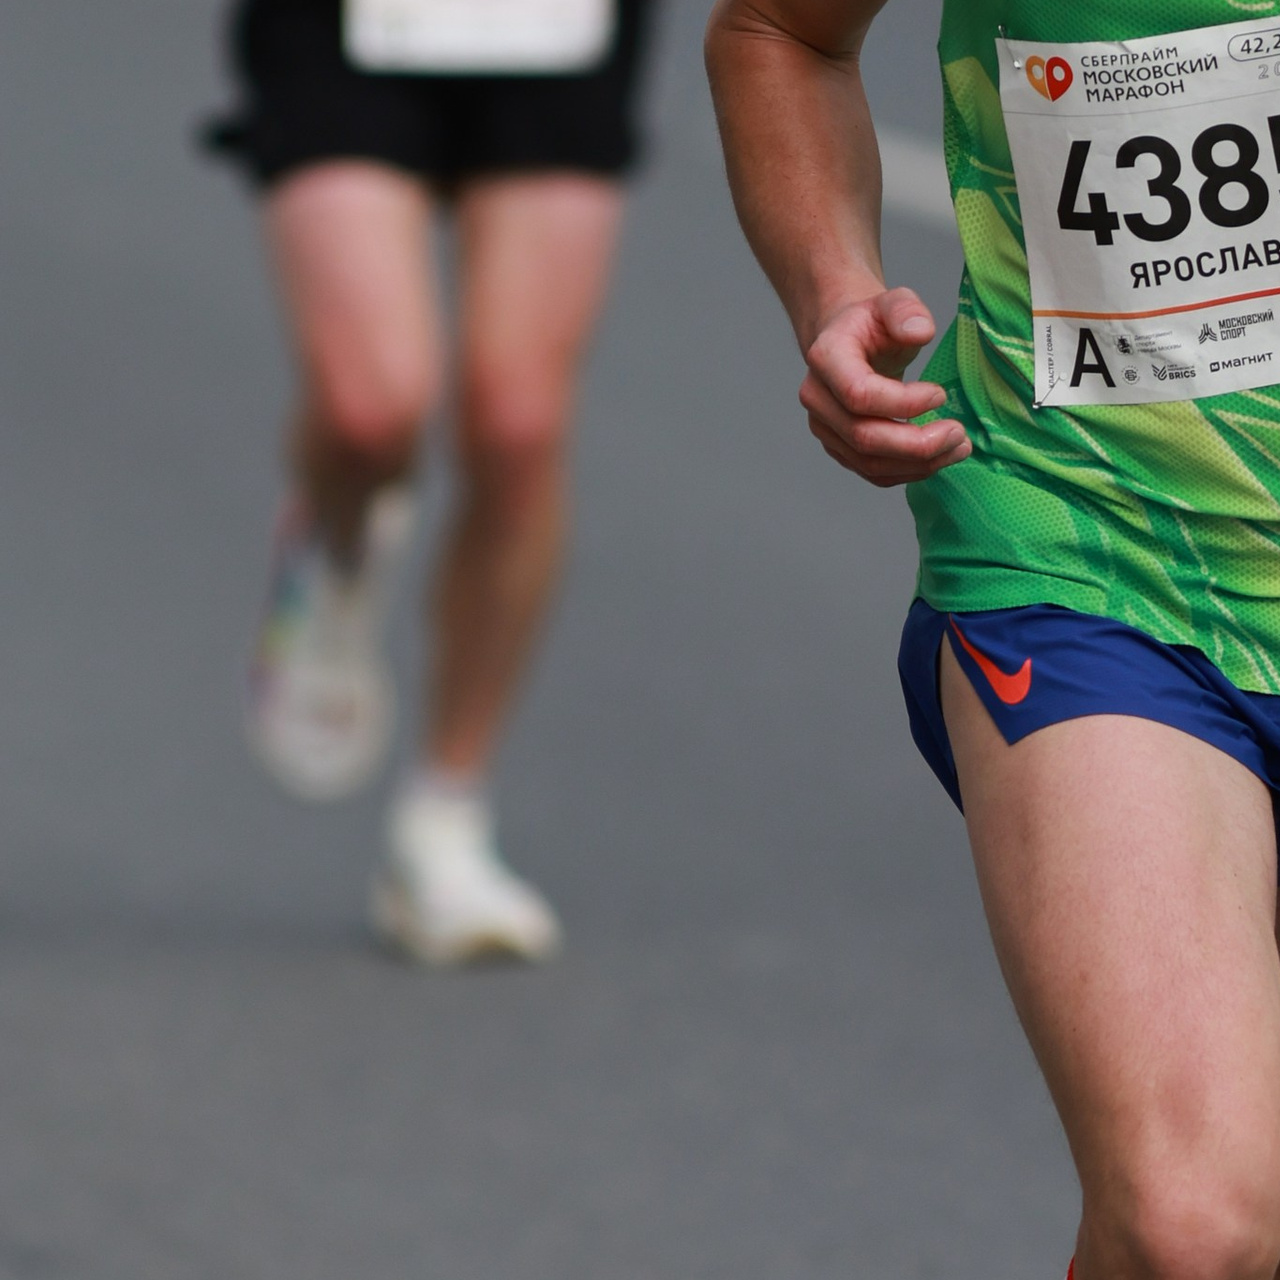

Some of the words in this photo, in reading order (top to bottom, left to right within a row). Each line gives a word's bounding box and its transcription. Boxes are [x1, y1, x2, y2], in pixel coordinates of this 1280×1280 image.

[1080, 47, 1179, 68] СБЕРПРАЙМ
[1083, 53, 1219, 86] МОСКОВСКИЙ
[1085, 79, 1185, 103] МАРАФОН
[1218, 308, 1275, 330] МОСКОВСКИЙ
[1220, 326, 1247, 341] СПОРТ
[1168, 370, 1196, 380] BRICS
